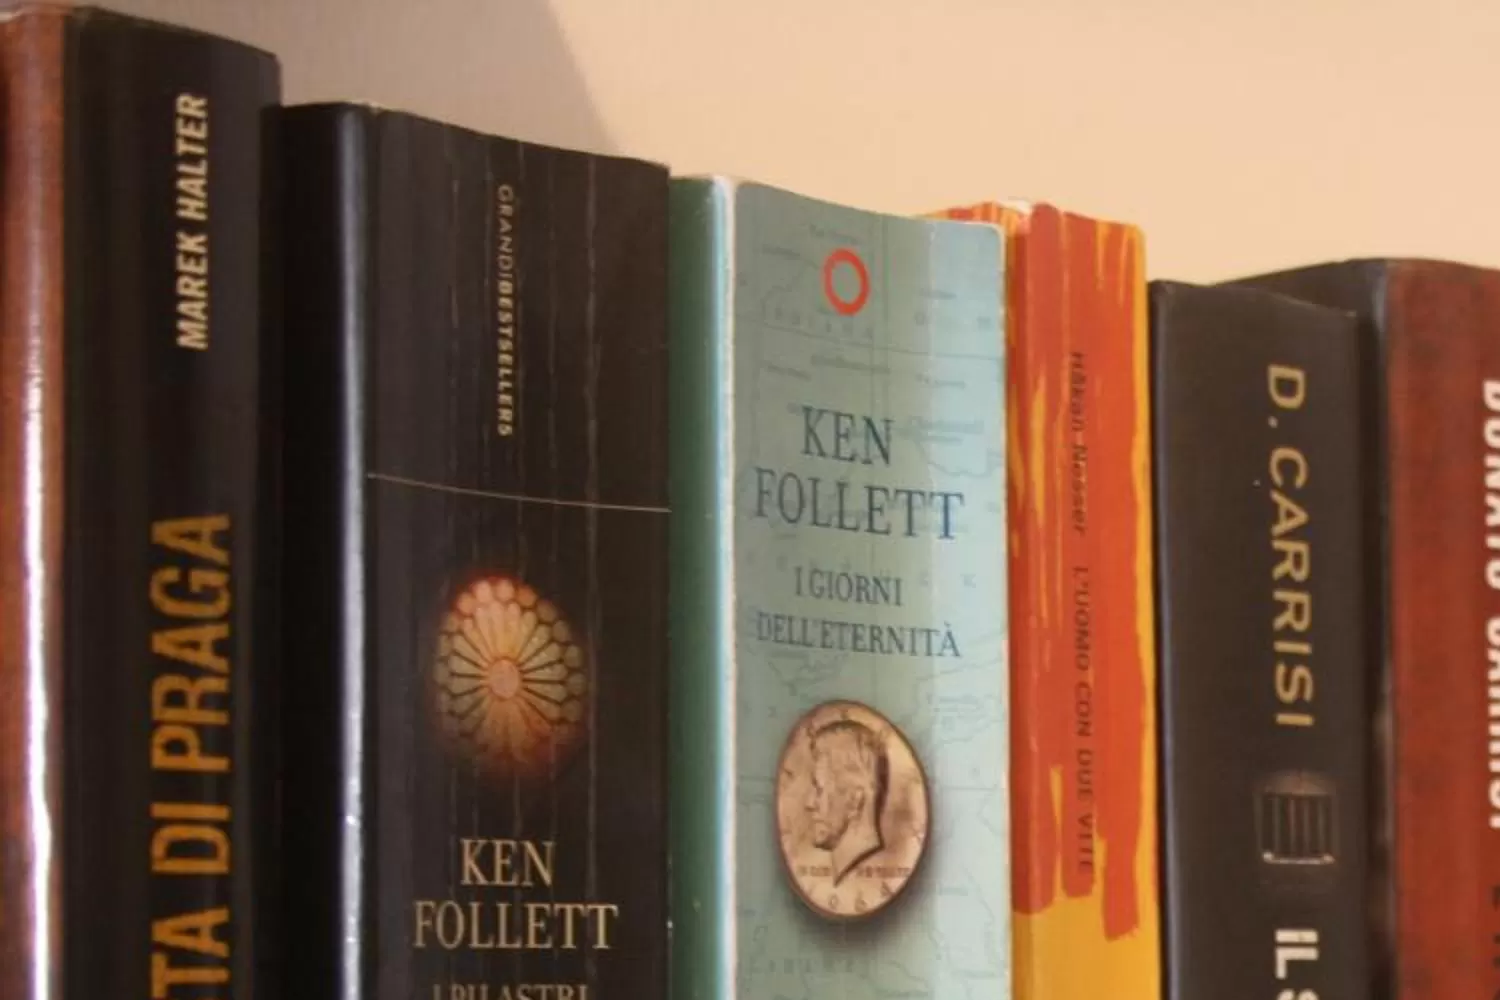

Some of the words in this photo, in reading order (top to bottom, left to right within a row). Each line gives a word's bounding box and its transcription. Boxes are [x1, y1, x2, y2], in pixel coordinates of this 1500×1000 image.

[178, 93, 209, 221] HALTER
[176, 232, 209, 352] MAREK
[1267, 364, 1306, 429] D.
[801, 404, 895, 466] KEN
[753, 465, 963, 541] FOLLETT
[793, 566, 805, 597] I
[808, 568, 904, 608] GIORNI
[1268, 446, 1314, 728] CARRISI
[149, 513, 232, 772] PRAGA
[755, 611, 963, 659] DELL'ETERNITÀ
[1076, 681, 1093, 737] CON
[150, 803, 231, 876] DI
[459, 838, 557, 889] KEN
[412, 901, 619, 952] FOLLETT
[1274, 928, 1320, 980] IL
